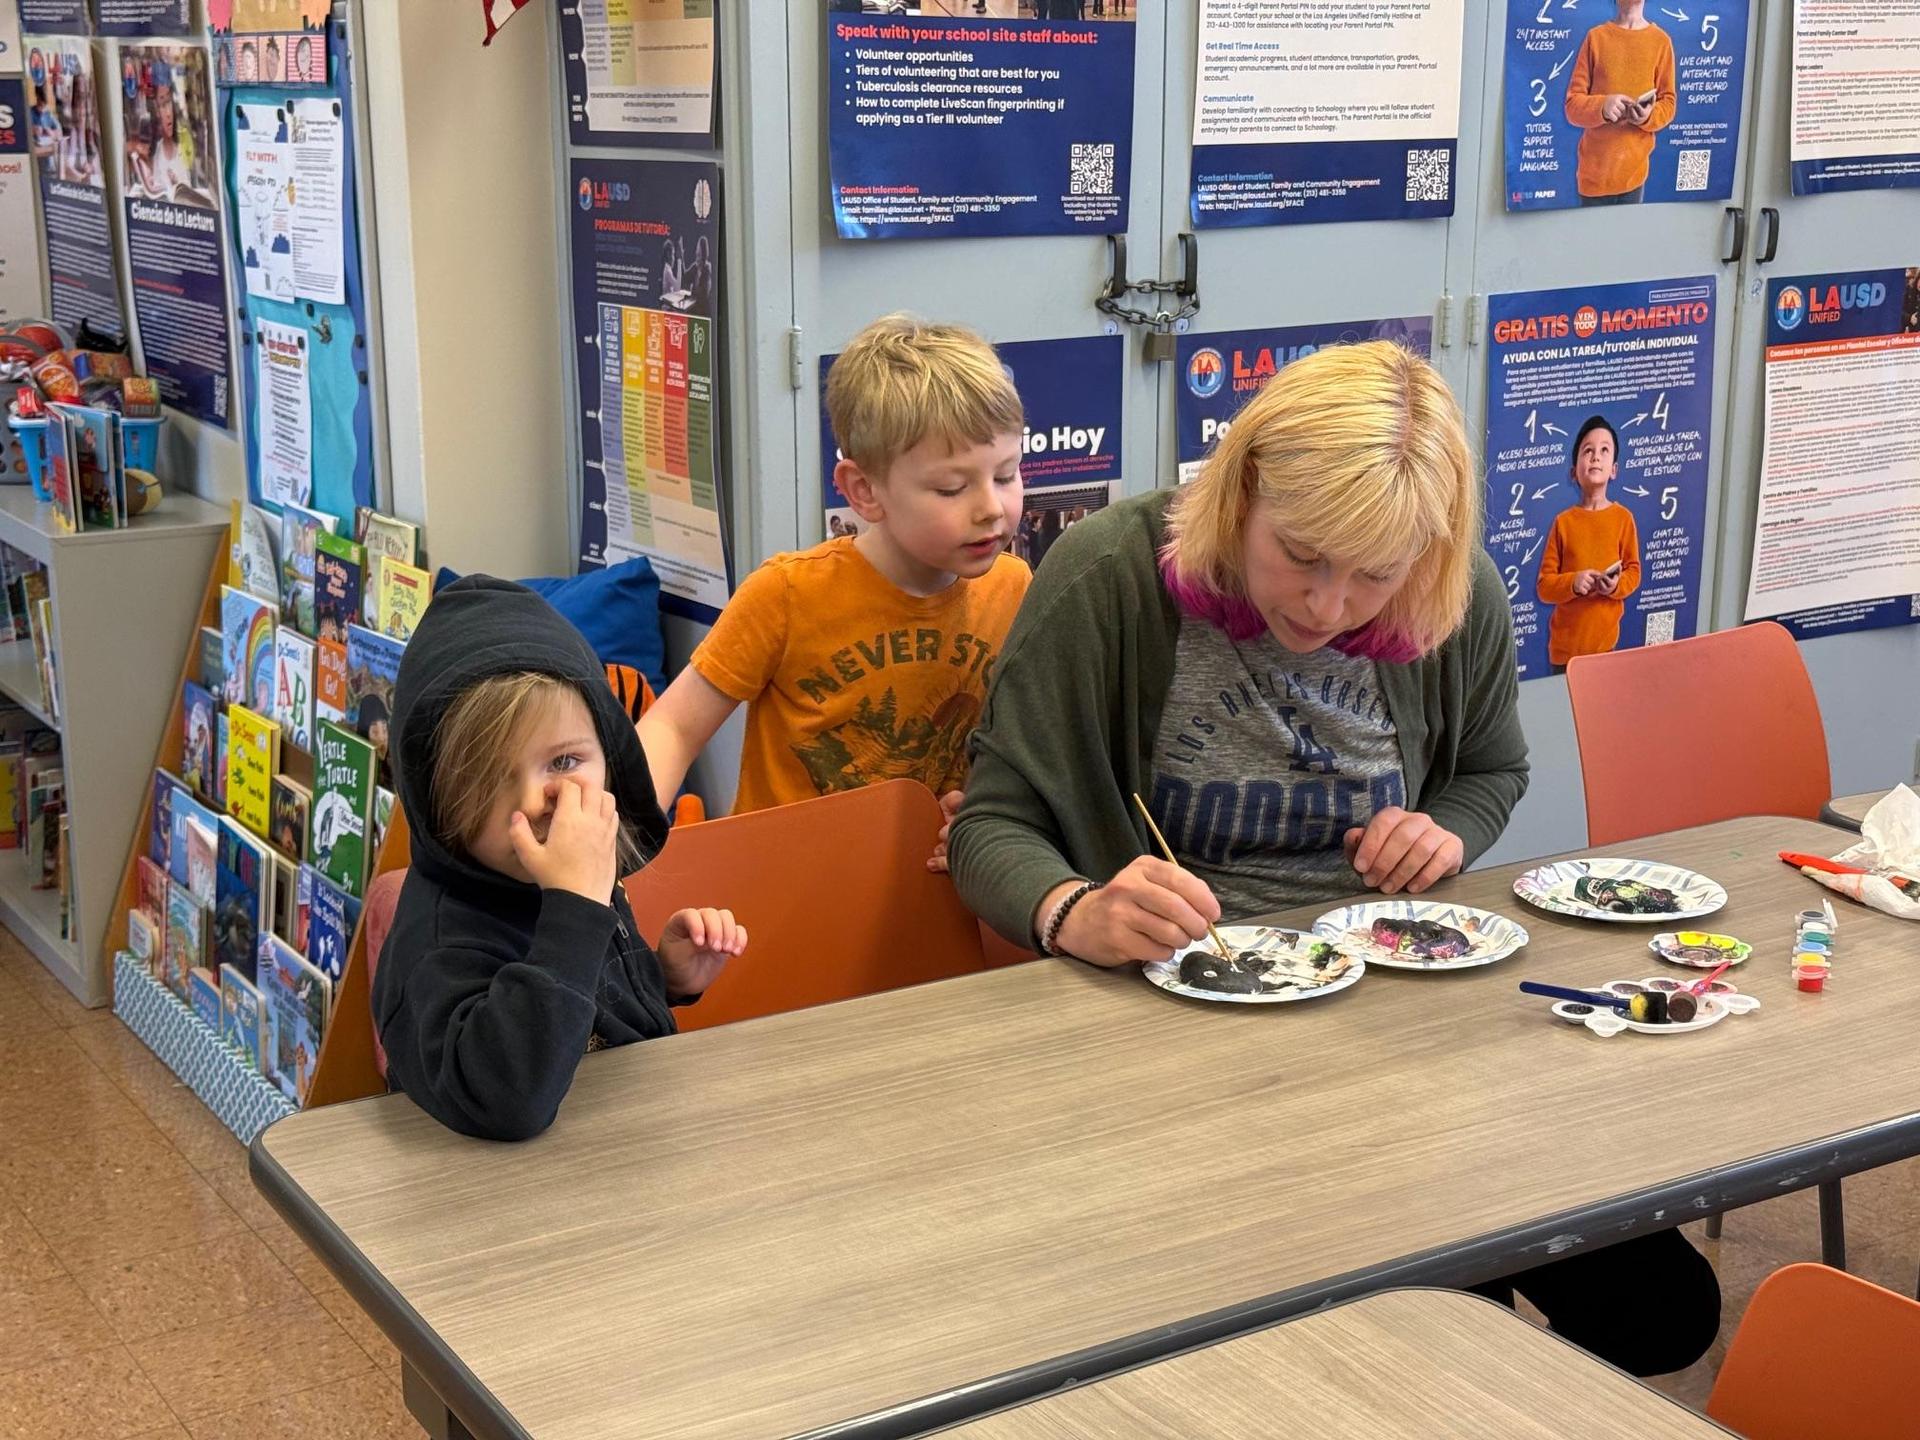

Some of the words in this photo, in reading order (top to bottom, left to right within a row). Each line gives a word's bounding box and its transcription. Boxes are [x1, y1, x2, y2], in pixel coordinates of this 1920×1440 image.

[837, 24, 877, 40] Speak
[880, 26, 908, 38] with
[911, 31, 943, 43] your
[946, 28, 989, 40] school
[992, 29, 1017, 41] site
[1019, 29, 1051, 42] staff
[1053, 31, 1097, 43] about:
[1516, 28, 1535, 40] 24/7
[1536, 29, 1571, 39] INSTANT
[1701, 15, 1719, 51] 5
[1526, 41, 1554, 50] ACCESS
[855, 49, 904, 60] Volunteer
[905, 50, 973, 64] opportunities
[1680, 57, 1695, 65] LIVE
[1696, 56, 1716, 65] CHAT
[1717, 56, 1732, 65] AND
[855, 65, 879, 75] Tiers
[881, 65, 891, 75] of
[893, 65, 956, 80] volunteering
[958, 67, 979, 77] that
[981, 69, 998, 77] are
[1000, 67, 1022, 78] best
[1024, 67, 1038, 78] for
[1040, 70, 1059, 81] you
[1682, 69, 1728, 78] INTERACTIVE
[856, 80, 918, 92] Tuberculosis
[920, 82, 971, 92] clearance
[973, 84, 1022, 93] resources
[1680, 82, 1704, 91] WHITE
[1705, 82, 1728, 90] BOARD
[1203, 93, 1253, 102] Communicate
[1529, 79, 1546, 116] 3
[1688, 94, 1720, 104] SUPPORT
[856, 97, 877, 106] How
[879, 97, 890, 107] to
[891, 97, 939, 110] complete
[941, 97, 984, 108] LiveScan
[987, 98, 1055, 112] fingerprinting
[1057, 98, 1064, 109] if
[856, 113, 900, 126] applying
[902, 115, 914, 123] as
[916, 115, 923, 123] a
[925, 113, 943, 123] Tier
[956, 113, 1003, 123] volunteer
[1526, 123, 1551, 133] TUTORS
[1524, 136, 1553, 146] SUPPORT
[1522, 149, 1554, 159] MULTIPLE
[1520, 162, 1558, 172] LANGUAGES
[1228, 172, 1273, 181] Information
[594, 182, 630, 201] LAUSD
[872, 185, 918, 194] Information
[1535, 190, 1556, 198] PAPER
[918, 196, 939, 204] Family
[941, 196, 954, 205] and
[954, 195, 993, 205] Community
[995, 195, 1036, 204] Engagement
[132, 201, 163, 224] Ciencia
[164, 206, 174, 225] de
[175, 208, 183, 226] la
[184, 210, 215, 232] Lectura
[595, 219, 633, 233] PROGRAMAS
[1809, 282, 1886, 311] LAUSD
[1584, 312, 1593, 320] EN
[1601, 302, 1708, 333] MOMENTO
[1809, 311, 1840, 324] UNIFIED
[1494, 314, 1568, 343] GRATIS
[1575, 321, 1595, 329] TODO
[1503, 351, 1535, 365] AYUDA
[1537, 349, 1557, 360] CON
[1560, 348, 1571, 358] LA
[1572, 338, 1645, 356] TAREA/TUTORÍA
[1647, 335, 1698, 348] INDIVIDUAL
[1652, 392, 1669, 430] 4
[1524, 410, 1537, 443] 1
[1052, 426, 1105, 455] Hoy
[1628, 436, 1649, 446] AYUDA
[1651, 435, 1665, 444] CON
[1666, 434, 1675, 442] LA
[1498, 448, 1523, 460] ACCESO
[1524, 445, 1549, 457] SEGURO
[1550, 444, 1563, 453] POR
[1634, 444, 1672, 456] REVISIONES
[1674, 443, 1683, 451] DE
[1685, 442, 1694, 451] LA
[1496, 462, 1516, 473] MEDIO
[1518, 460, 1527, 469] DE
[1528, 455, 1565, 468] SCHOOLOGY
[1665, 454, 1686, 463] APOYO
[1688, 452, 1702, 461] CON
[1644, 468, 1651, 476] EL
[1653, 464, 1681, 475] ESTUDIO
[1509, 483, 1525, 515] 2
[1661, 487, 1679, 520] 5
[1500, 518, 1524, 529] ACCESO
[1653, 528, 1673, 539] CHAT
[1673, 527, 1684, 536] EN
[1646, 540, 1660, 550] VIVO
[1662, 540, 1667, 548] Y
[1668, 536, 1689, 546] APOYO
[1646, 547, 1689, 560] INTERACTIVO
[1652, 561, 1666, 570] CON
[1667, 559, 1681, 568] UNA
[1652, 569, 1680, 580] PIZARRA
[1505, 566, 1520, 600] 3
[796, 629, 942, 705] NEVER
[950, 633, 999, 689] STO
[1278, 706, 1342, 774] LA
[317, 728, 346, 768] YERTLE
[326, 764, 358, 788] TURTLE
